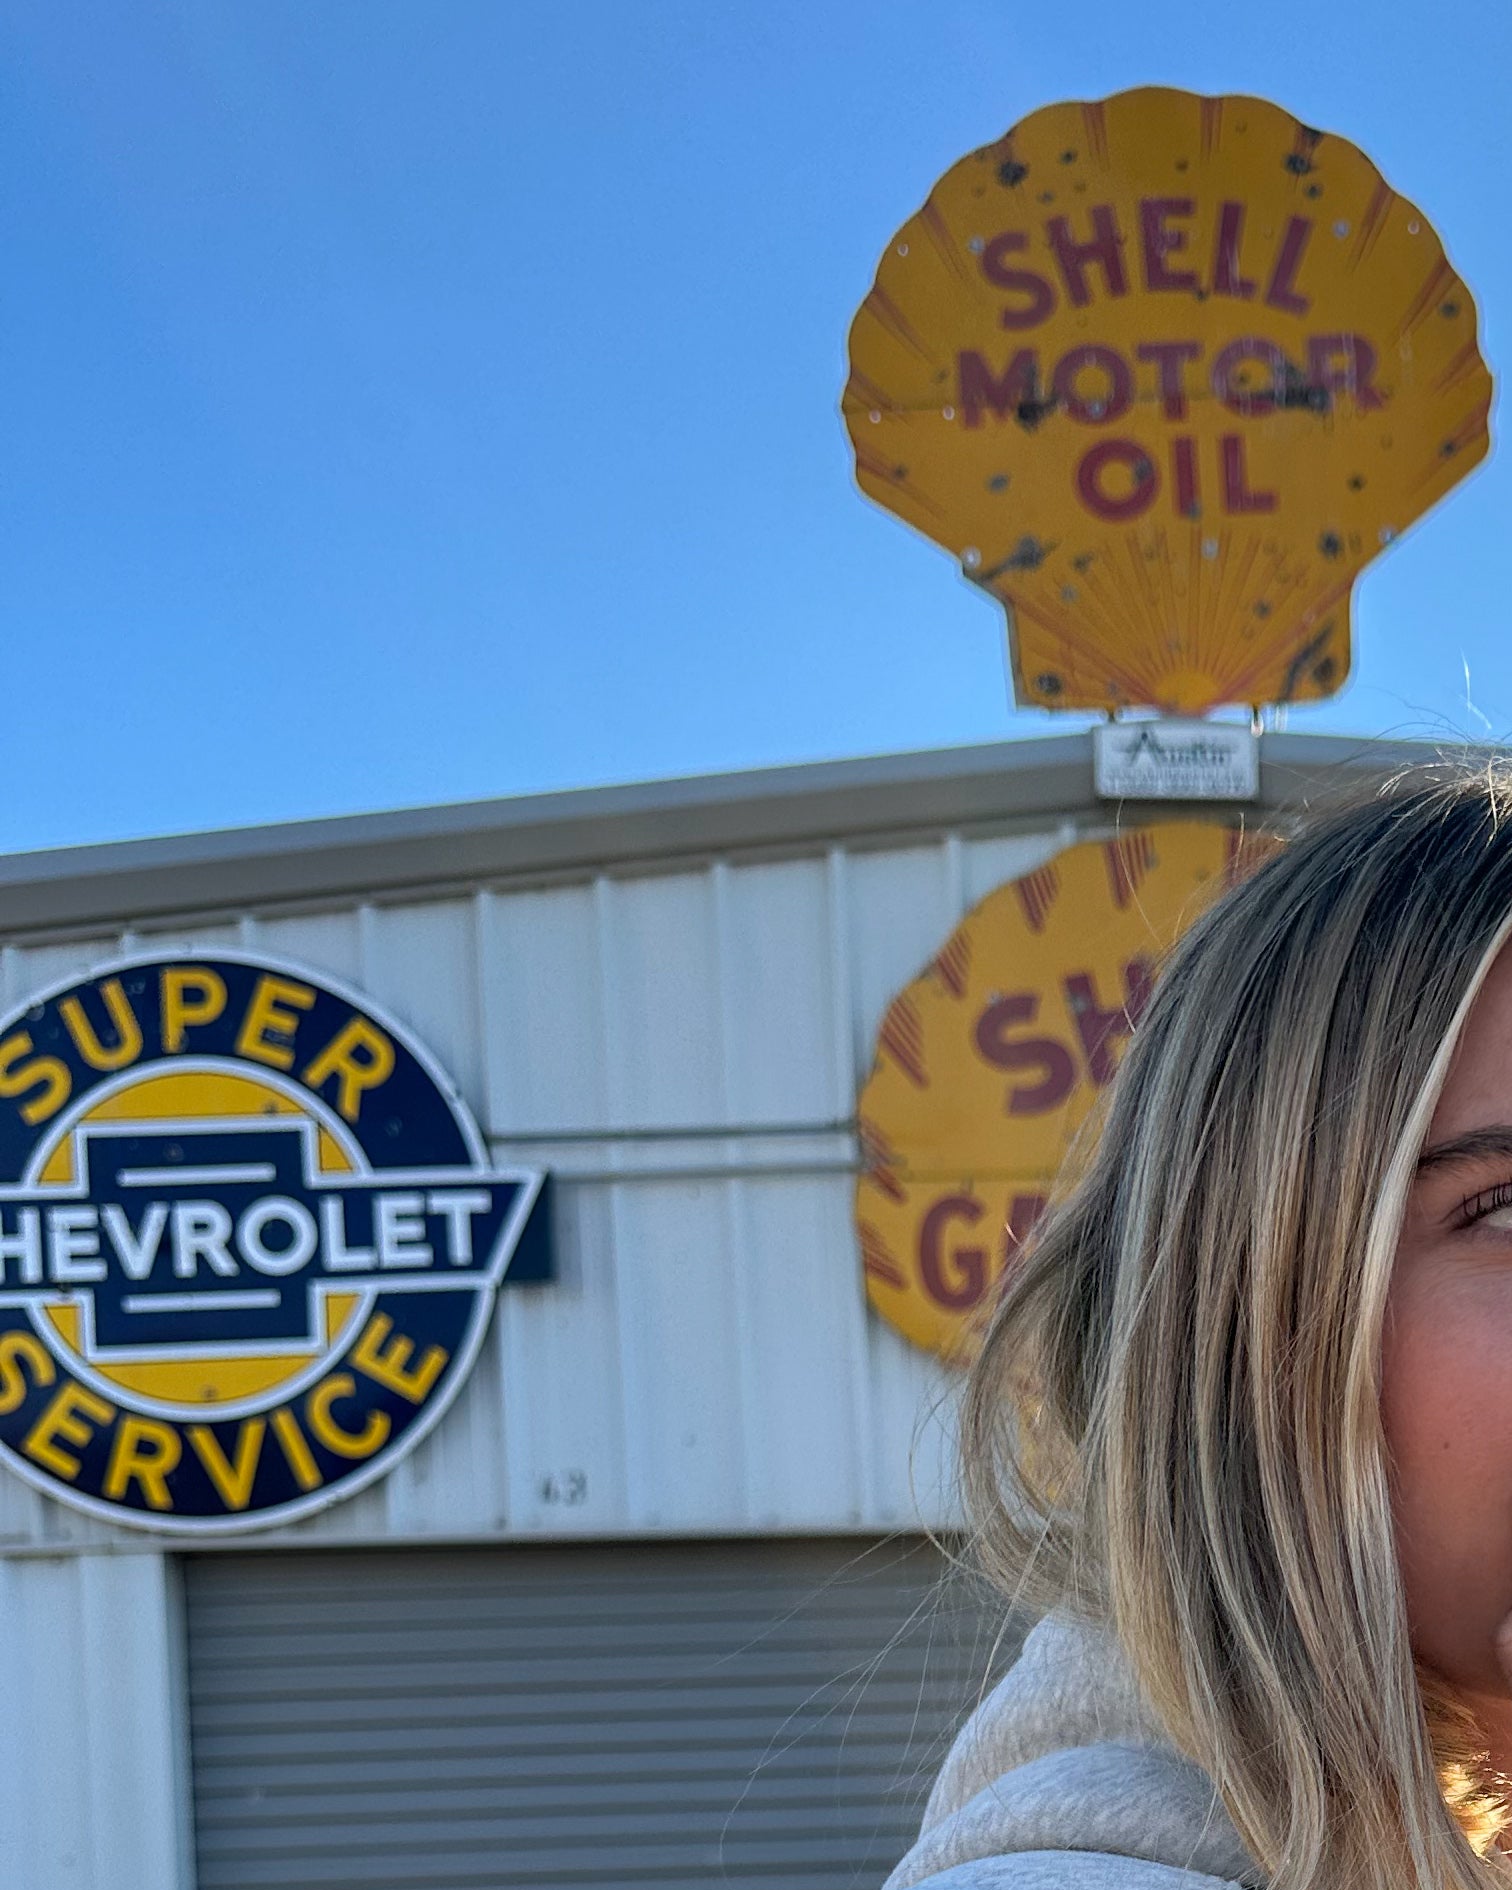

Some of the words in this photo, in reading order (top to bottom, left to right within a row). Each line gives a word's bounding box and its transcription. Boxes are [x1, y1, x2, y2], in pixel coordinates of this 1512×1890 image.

[981, 198, 1317, 330] SHELL
[954, 334, 1388, 430] MOTOR
[1075, 434, 1279, 523] OIL
[0, 967, 397, 1126] SUPER
[976, 957, 1153, 1117] SH
[0, 1312, 449, 1510] SERVICE
